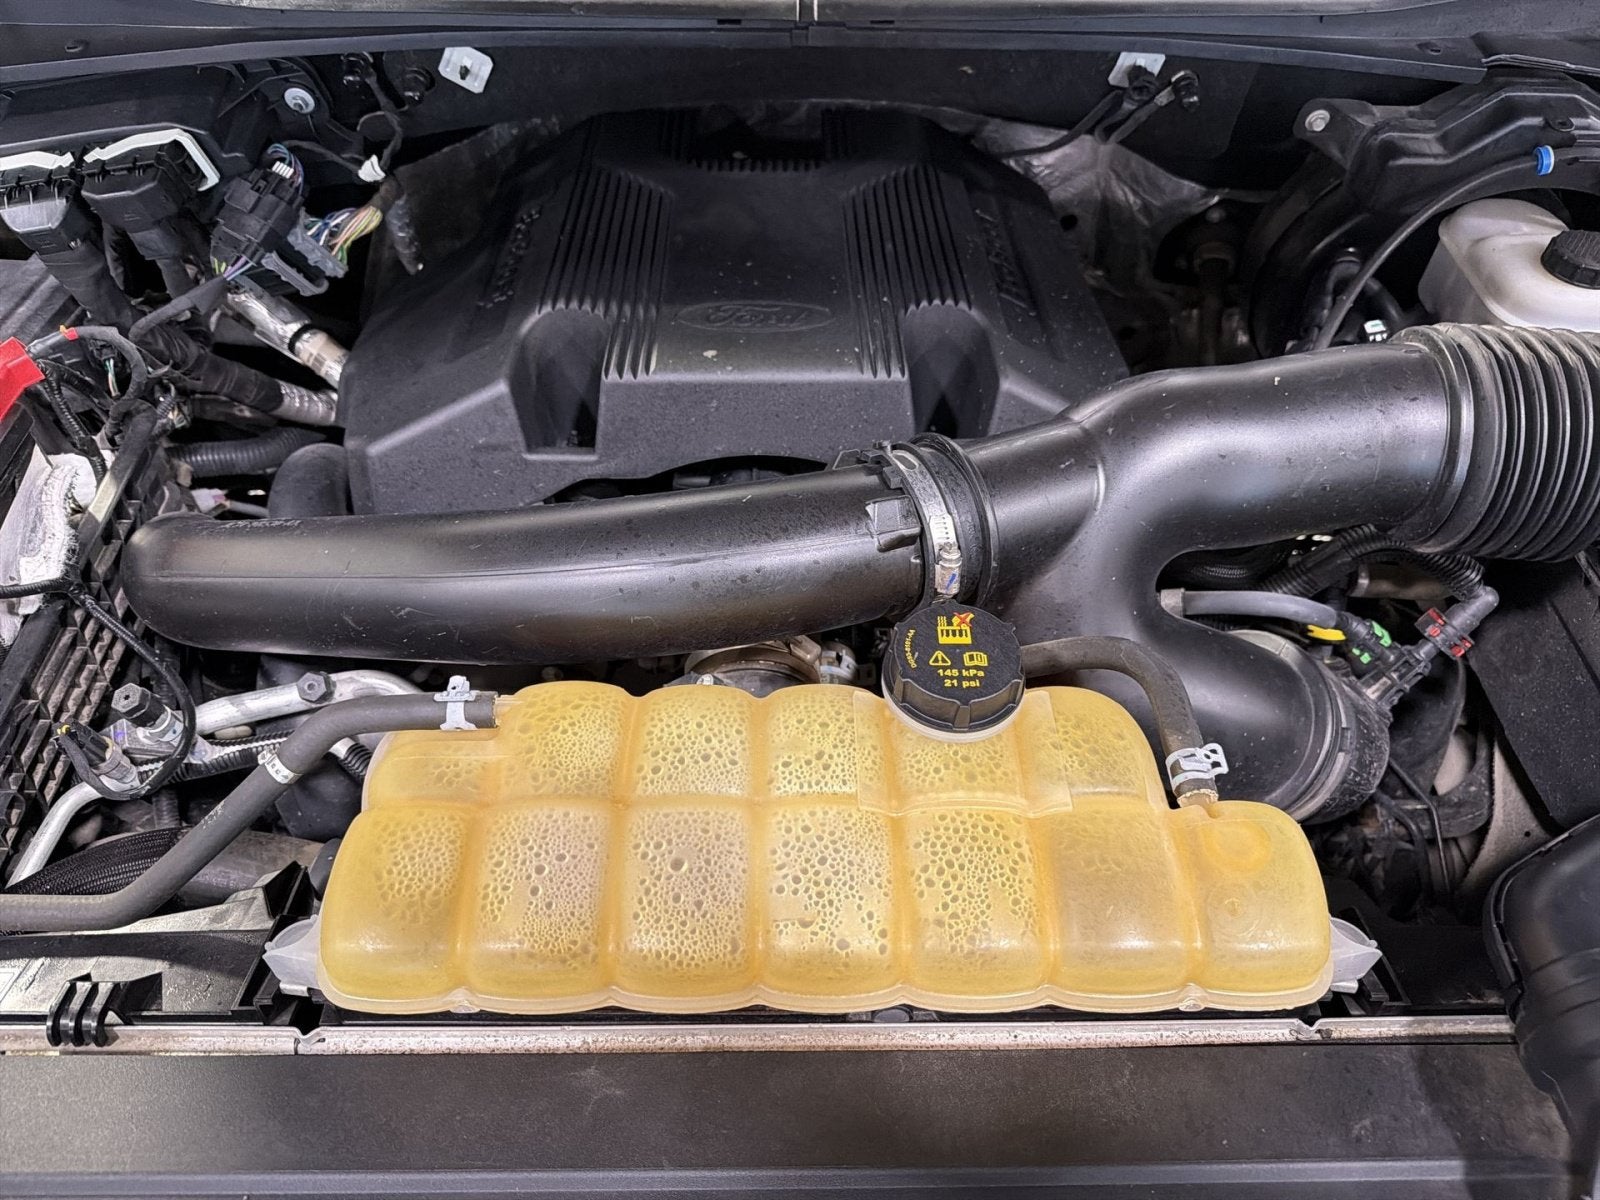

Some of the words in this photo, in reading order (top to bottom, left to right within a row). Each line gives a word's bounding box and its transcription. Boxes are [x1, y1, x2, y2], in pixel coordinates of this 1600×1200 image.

[937, 669, 959, 677] 145
[962, 669, 985, 677] kPa
[944, 679, 958, 687] 21
[962, 679, 981, 689] psi
